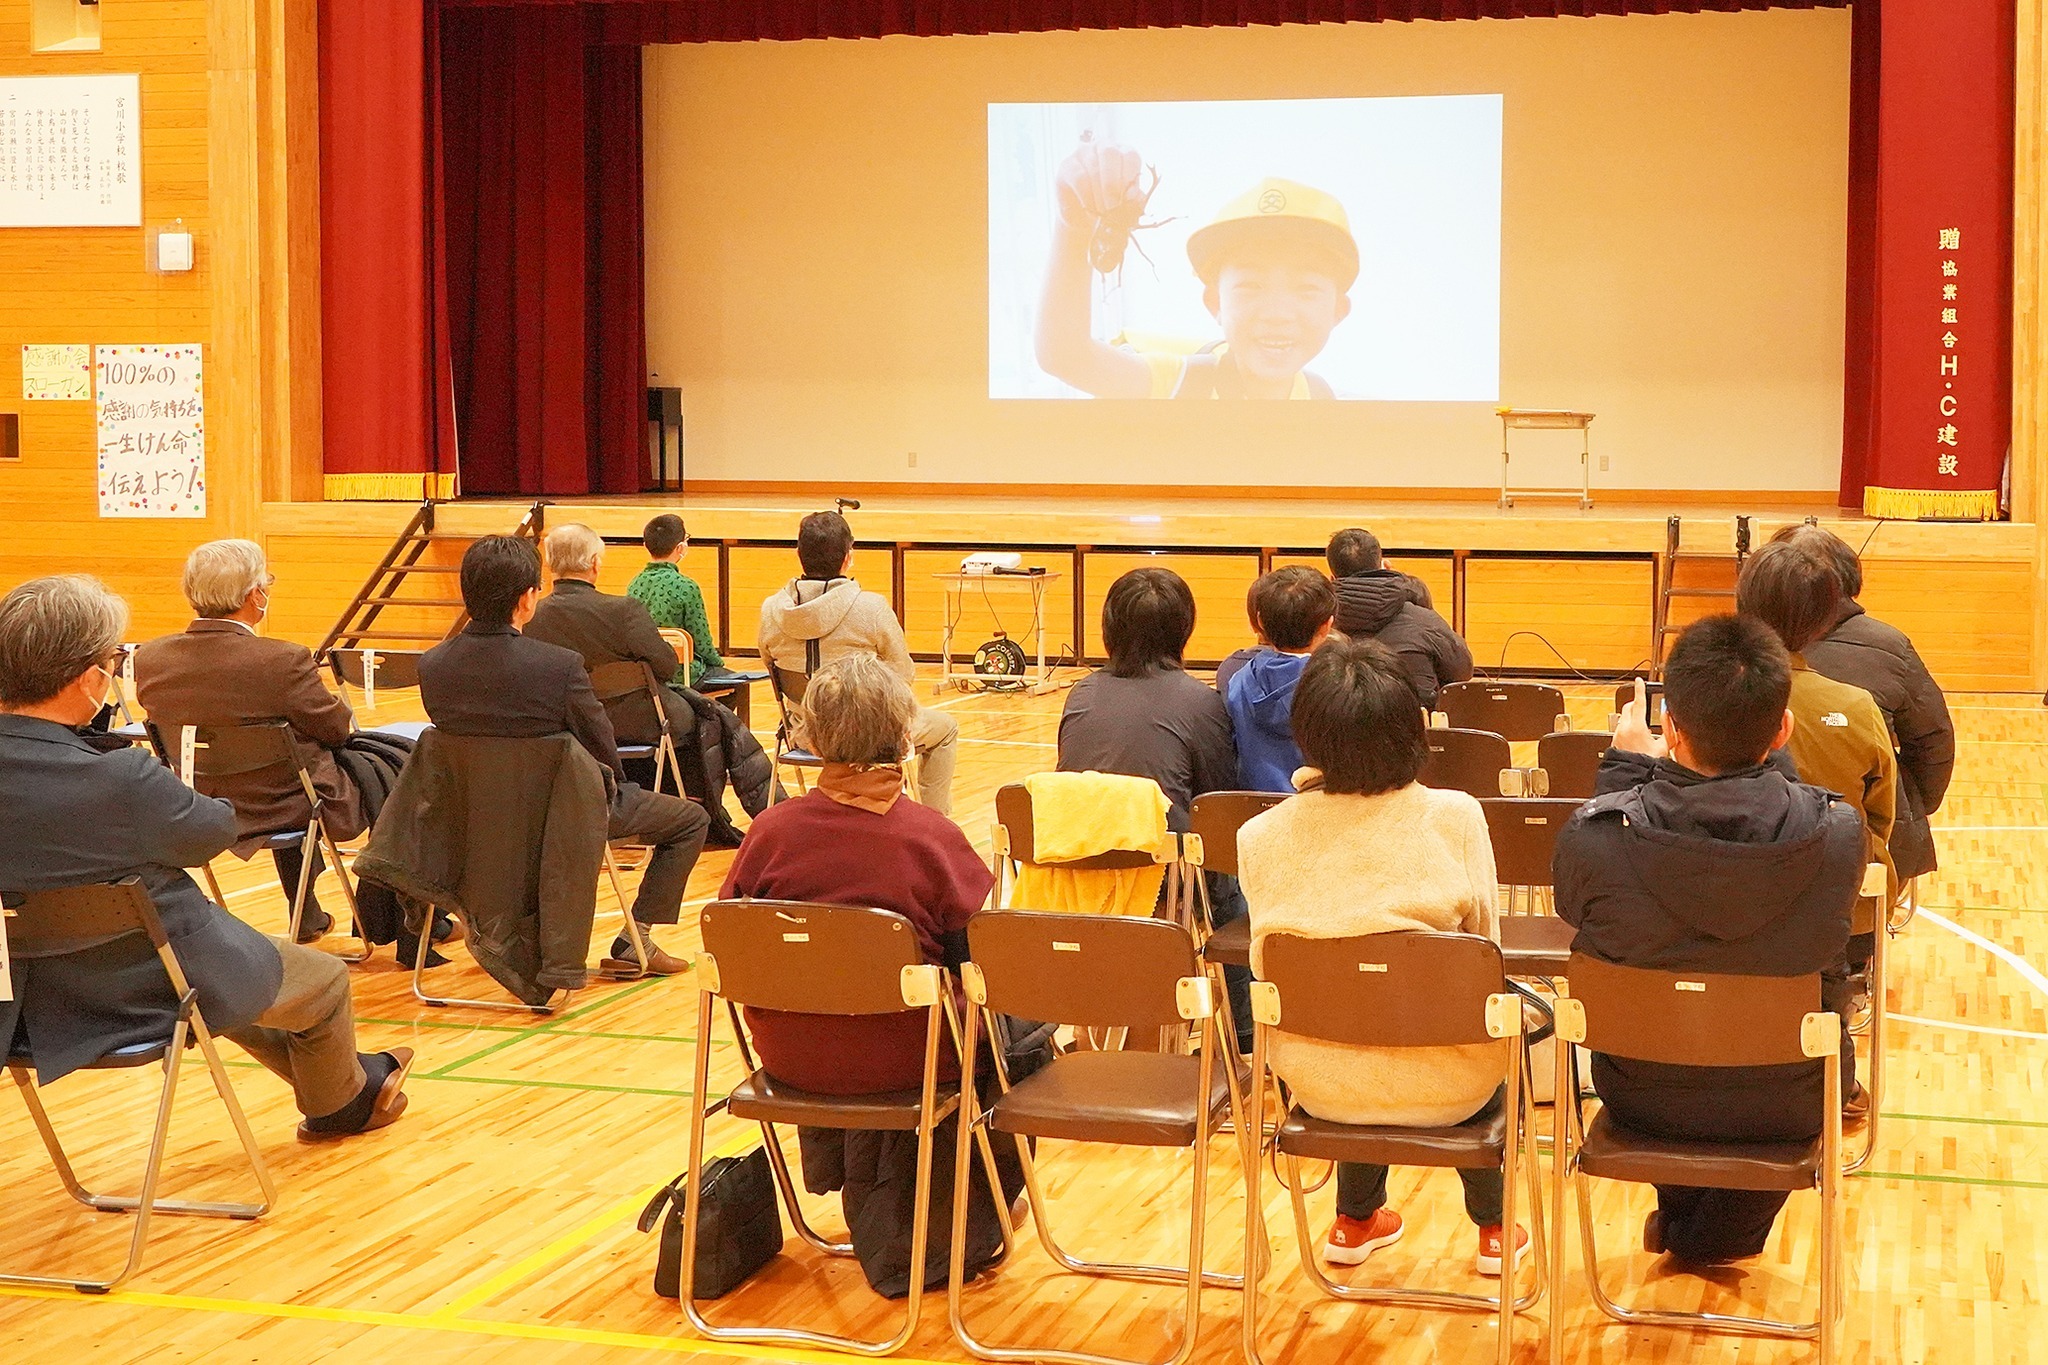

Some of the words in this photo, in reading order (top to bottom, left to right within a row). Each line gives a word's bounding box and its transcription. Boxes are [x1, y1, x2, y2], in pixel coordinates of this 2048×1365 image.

[115, 97, 126, 156] 宮川小学校
[116, 160, 127, 184] 校歌
[1938, 227, 1961, 250] 贈
[24, 347, 88, 368] 感謝の会
[24, 376, 86, 393] スローガン
[104, 362, 176, 386] 100%の
[102, 396, 198, 421] 感謝の気持ちを
[104, 430, 190, 455] 一生けん命
